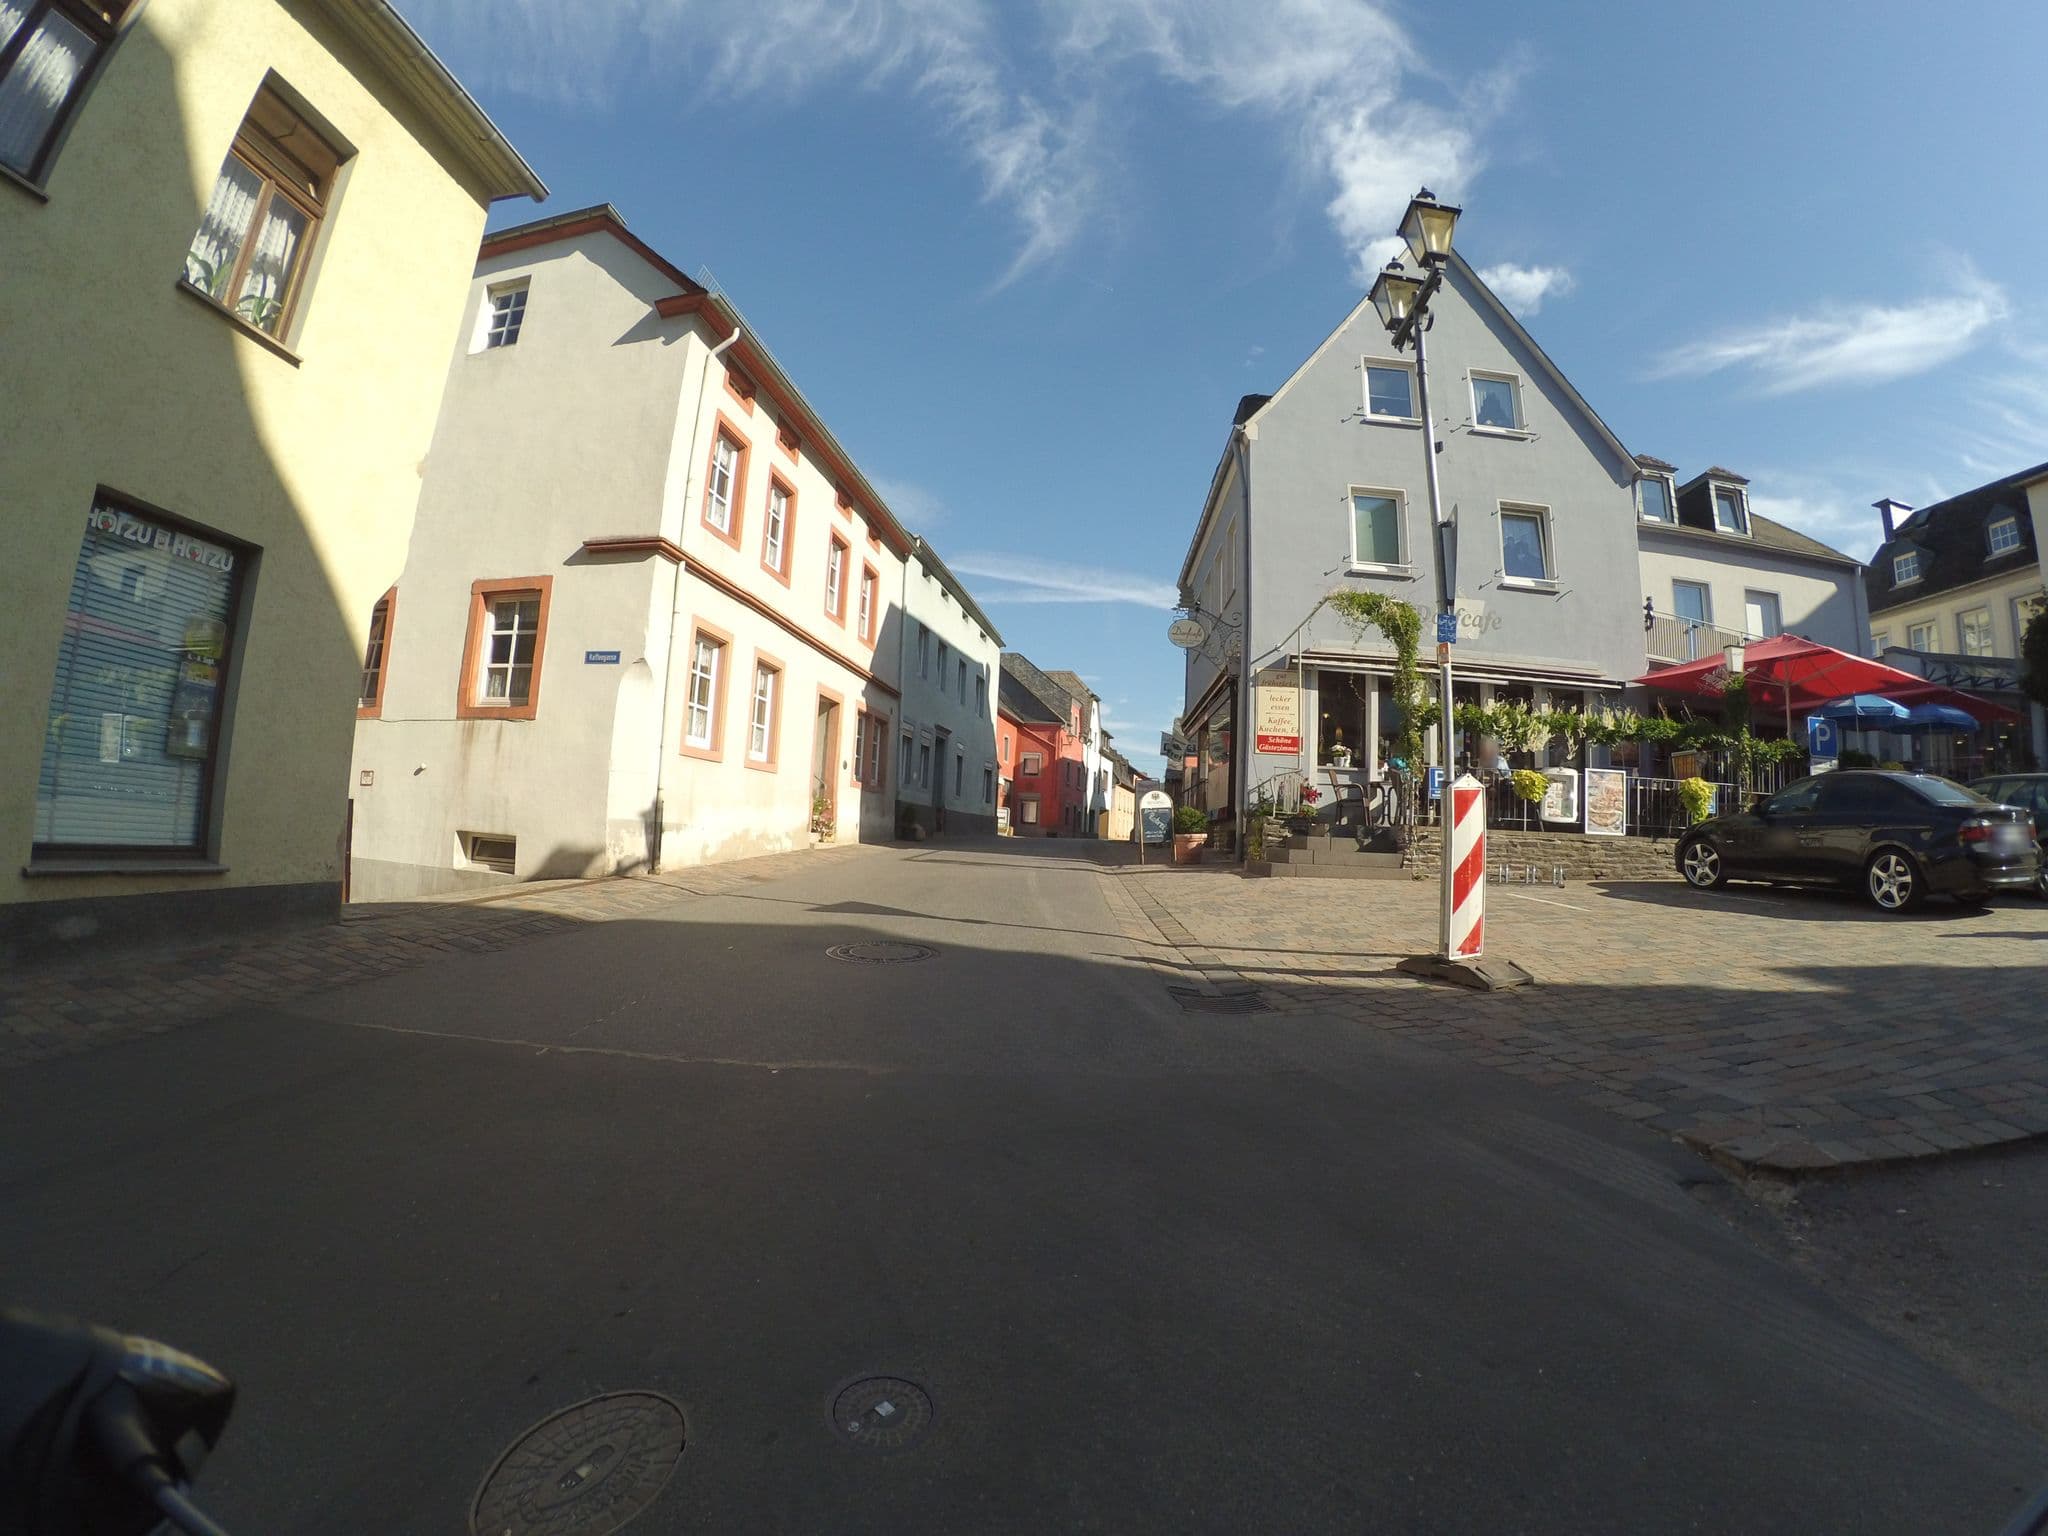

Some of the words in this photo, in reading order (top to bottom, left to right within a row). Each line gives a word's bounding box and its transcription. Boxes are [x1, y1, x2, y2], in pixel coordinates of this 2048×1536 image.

[1269, 694, 1292, 703] lecker
[1815, 722, 1831, 751] P
[1434, 770, 1445, 788] P
